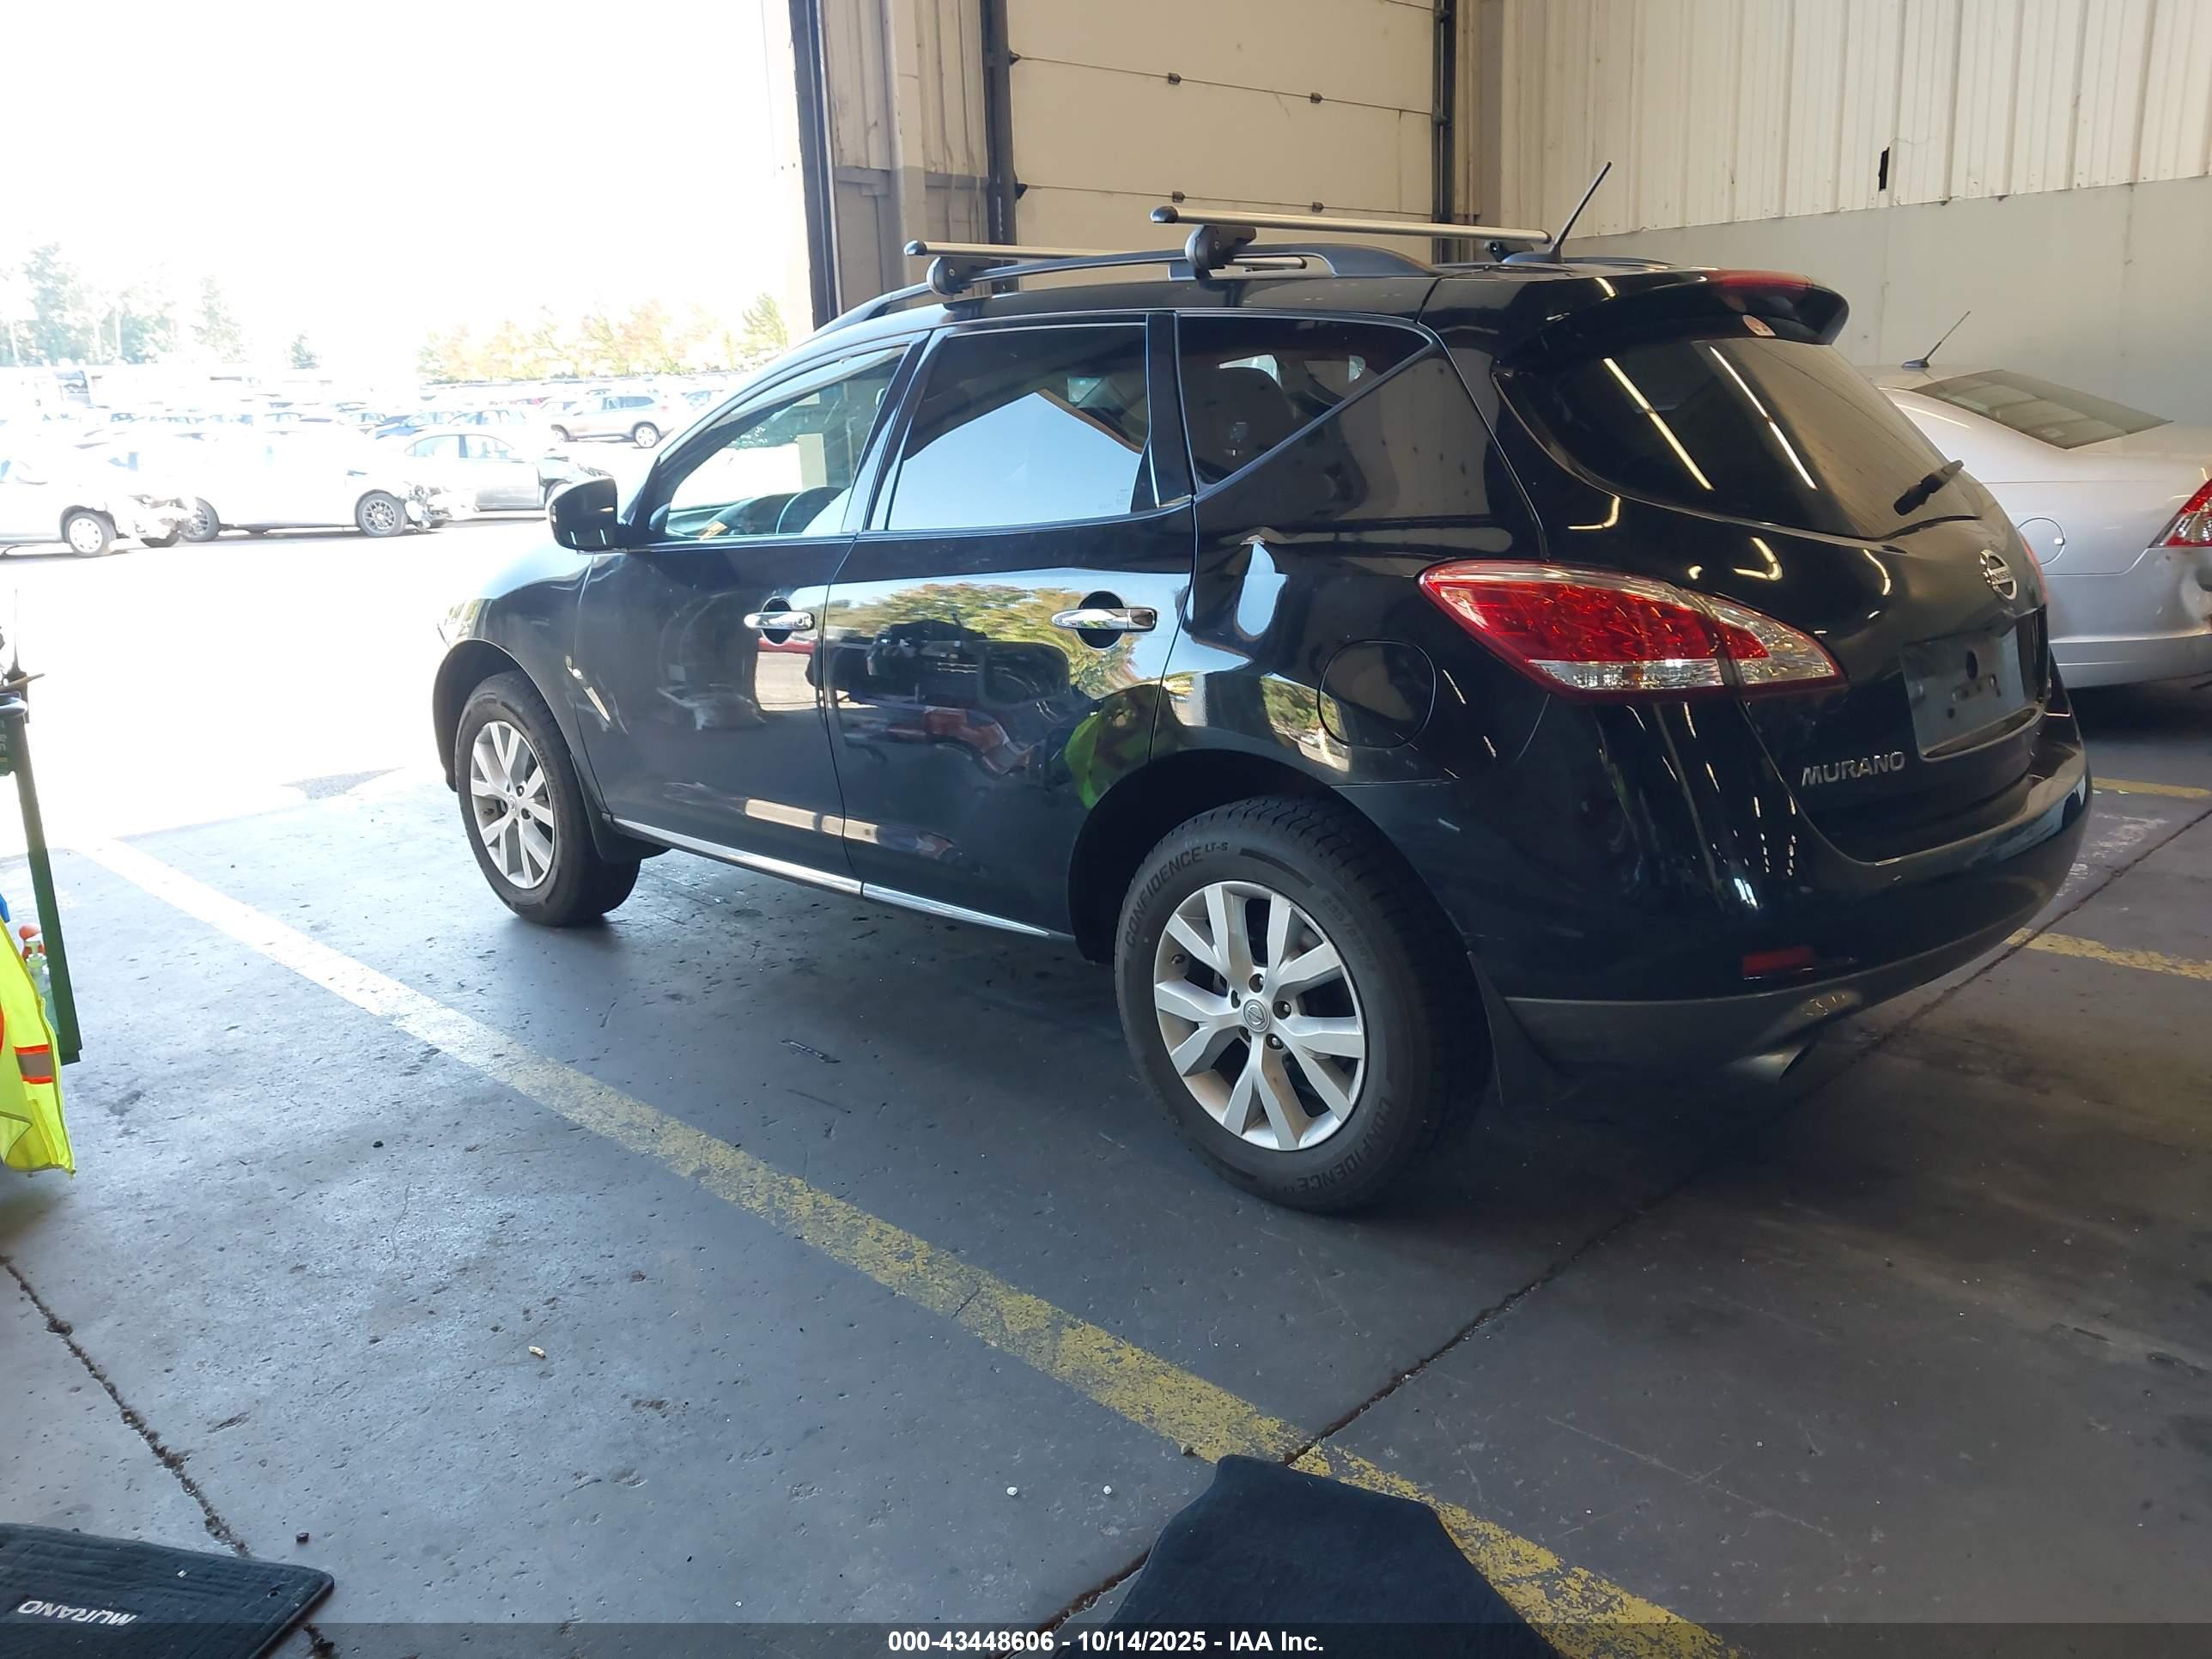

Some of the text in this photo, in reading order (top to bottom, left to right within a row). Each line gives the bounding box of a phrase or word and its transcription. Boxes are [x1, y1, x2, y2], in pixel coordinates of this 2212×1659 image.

[1802, 751, 1905, 787] MURANO
[1125, 842, 1229, 946] CONFIDENCE LT-S
[17, 1600, 137, 1626] MURANO
